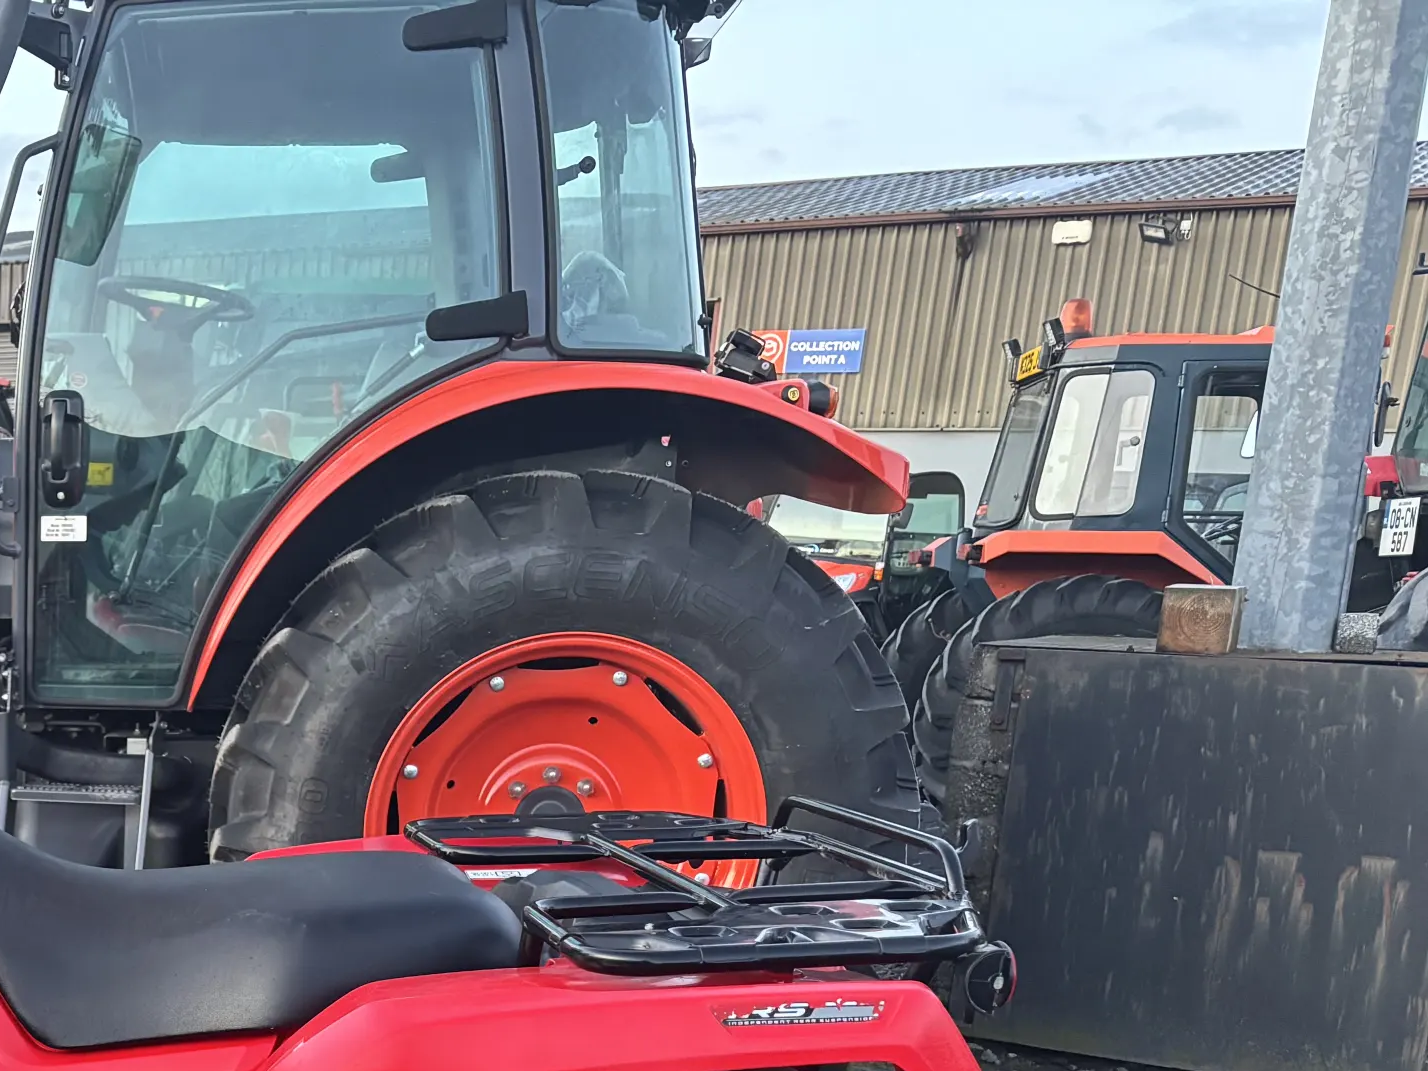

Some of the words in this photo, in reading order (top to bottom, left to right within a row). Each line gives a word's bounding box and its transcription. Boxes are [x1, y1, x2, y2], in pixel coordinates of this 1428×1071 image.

[790, 341, 860, 352] COLLECTION
[803, 354, 837, 365] POINT
[837, 354, 846, 365] A
[1390, 507, 1418, 529] 08-CN
[1391, 531, 1408, 552] 587
